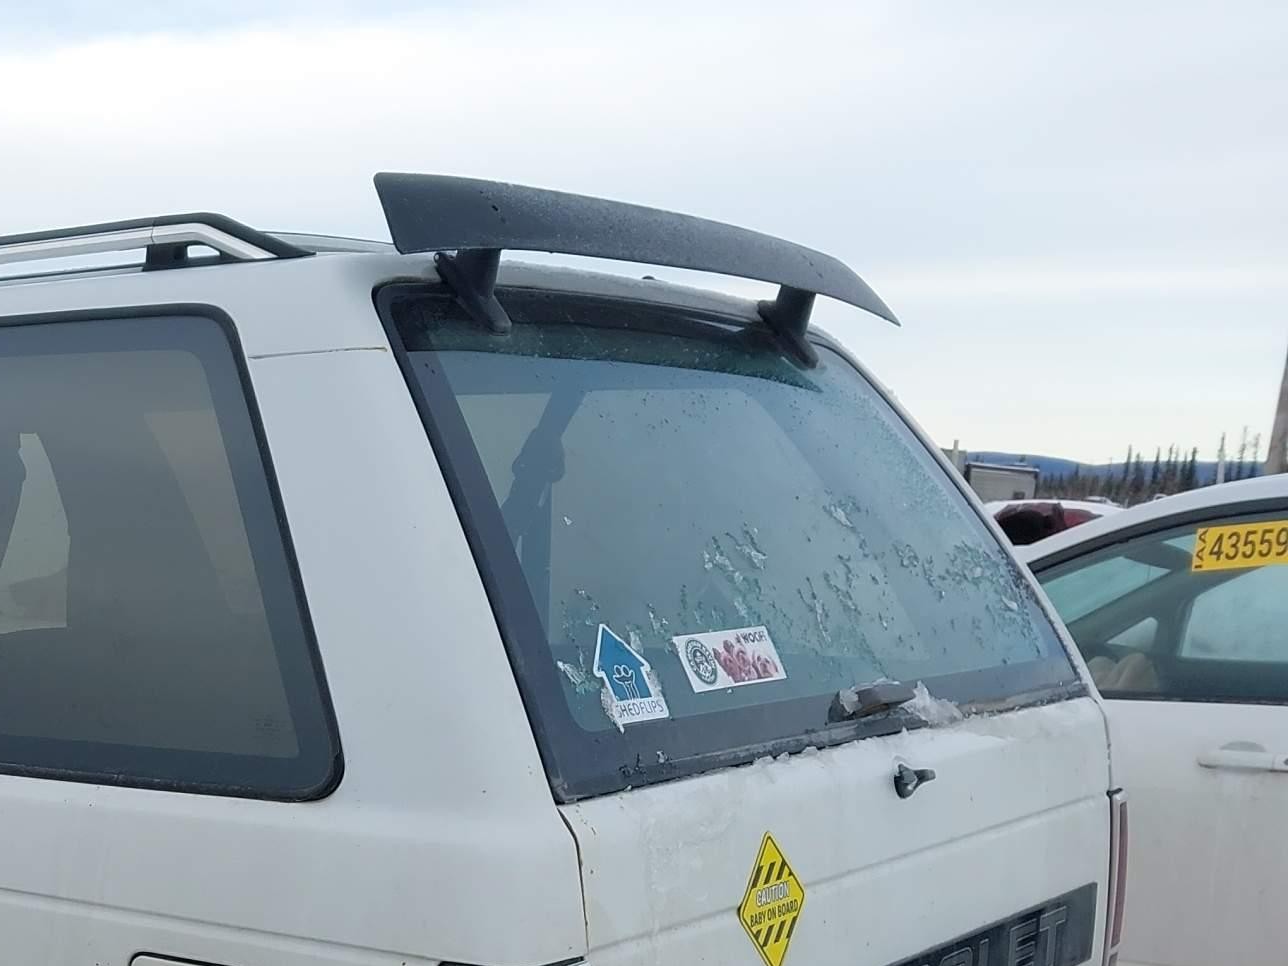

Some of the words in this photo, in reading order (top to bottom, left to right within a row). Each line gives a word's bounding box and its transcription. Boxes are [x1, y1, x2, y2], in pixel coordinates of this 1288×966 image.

[1194, 528, 1209, 569] IAA
[755, 880, 790, 907] CAUTION
[750, 909, 767, 928] BABY
[767, 906, 777, 922] ON
[777, 898, 799, 918] BOARD
